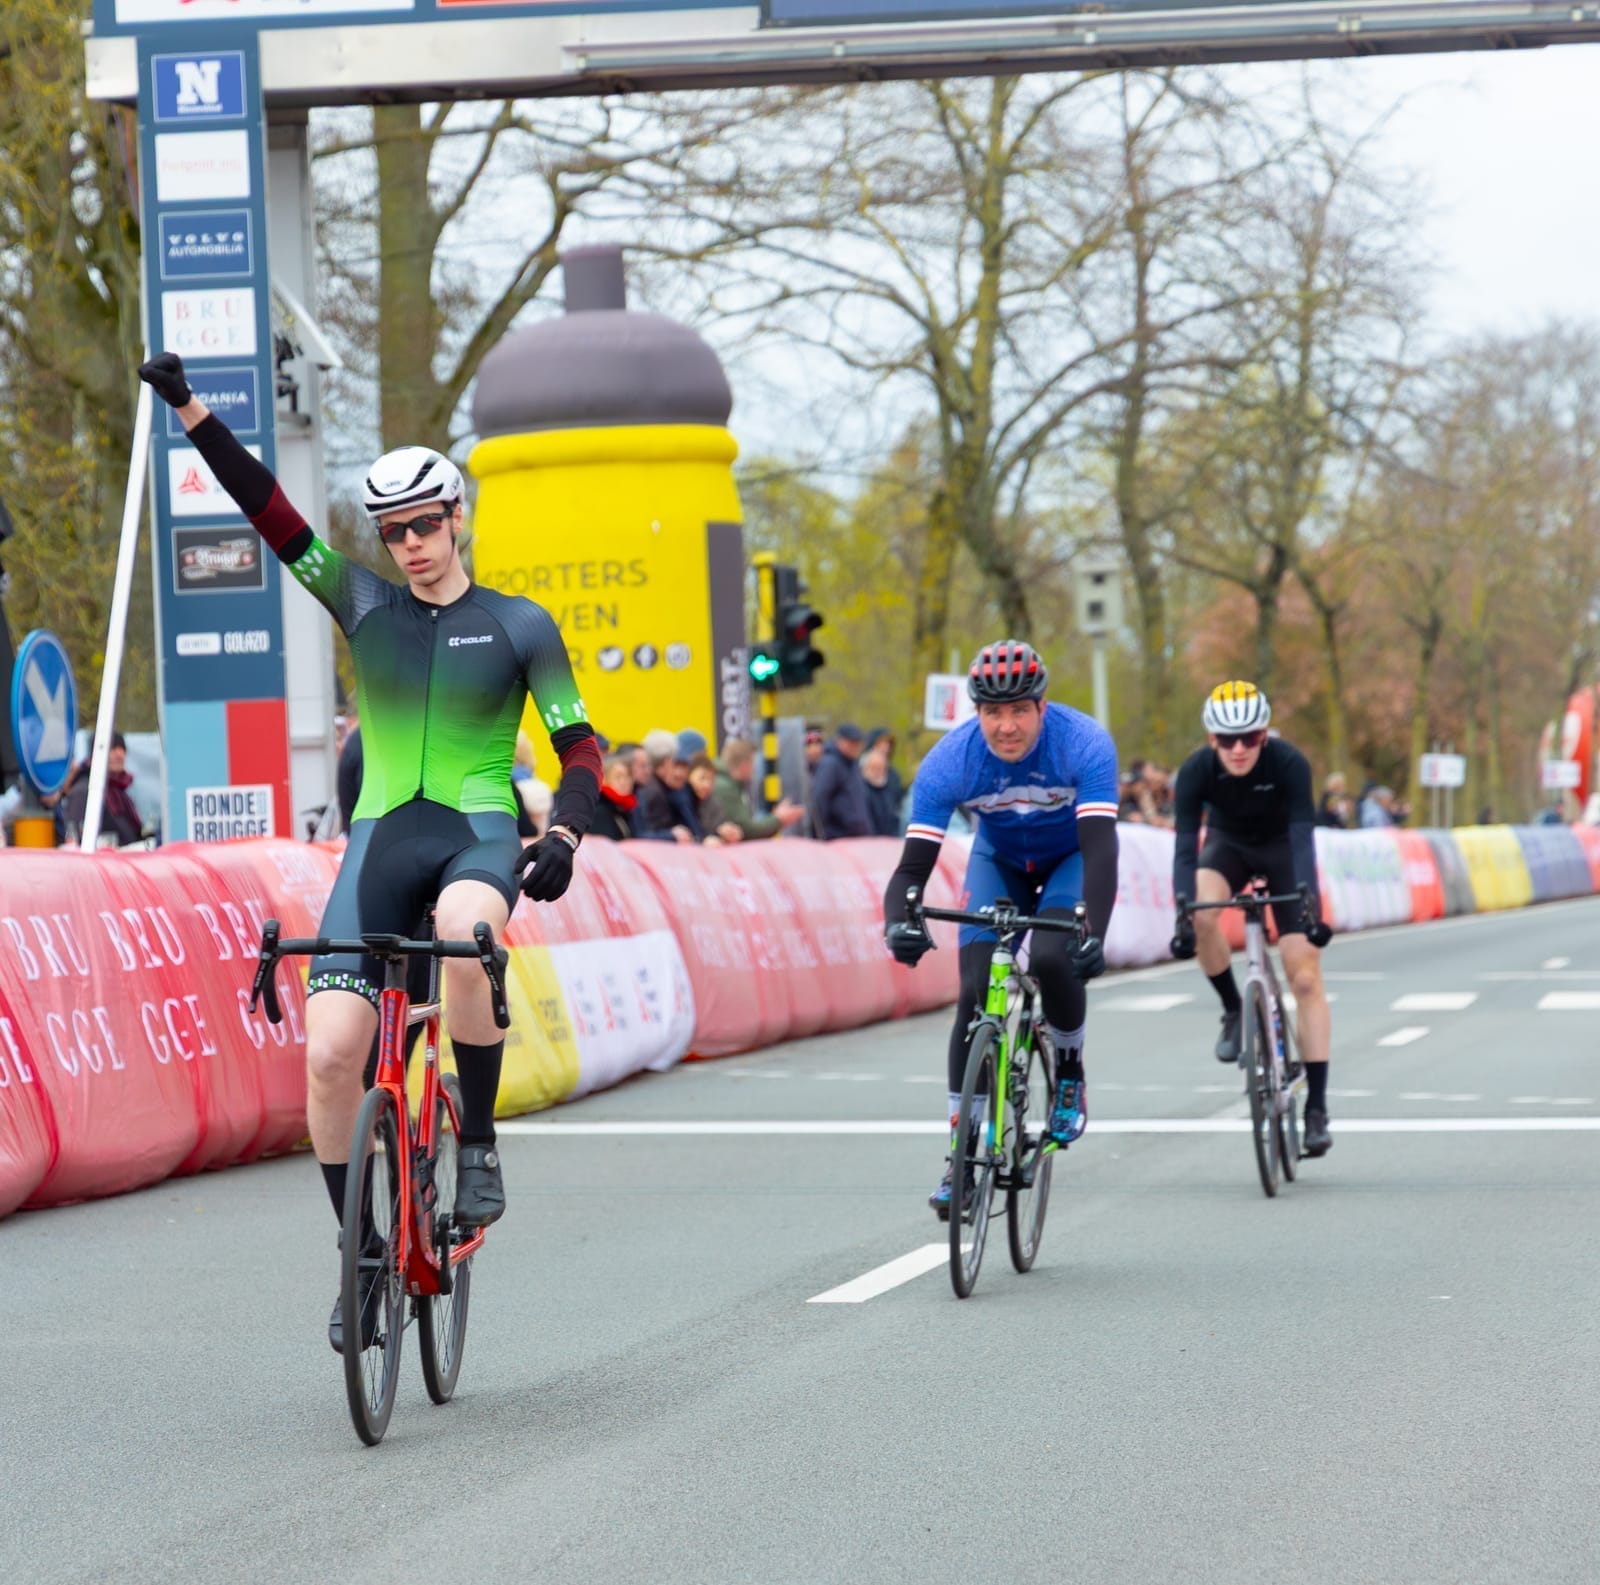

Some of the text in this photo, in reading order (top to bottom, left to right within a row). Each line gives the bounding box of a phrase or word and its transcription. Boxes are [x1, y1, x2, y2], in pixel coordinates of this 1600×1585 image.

[175, 60, 222, 105] N
[167, 243, 245, 256] AUTOMOBILIA
[168, 231, 245, 246] VOLVO
[176, 297, 241, 321] BRU
[175, 326, 243, 347] GGE
[193, 791, 256, 817] RONDE
[2, 913, 90, 980] BRU
[99, 906, 185, 971] BRU
[46, 1007, 126, 1077] GGE
[141, 995, 217, 1064] GGE
